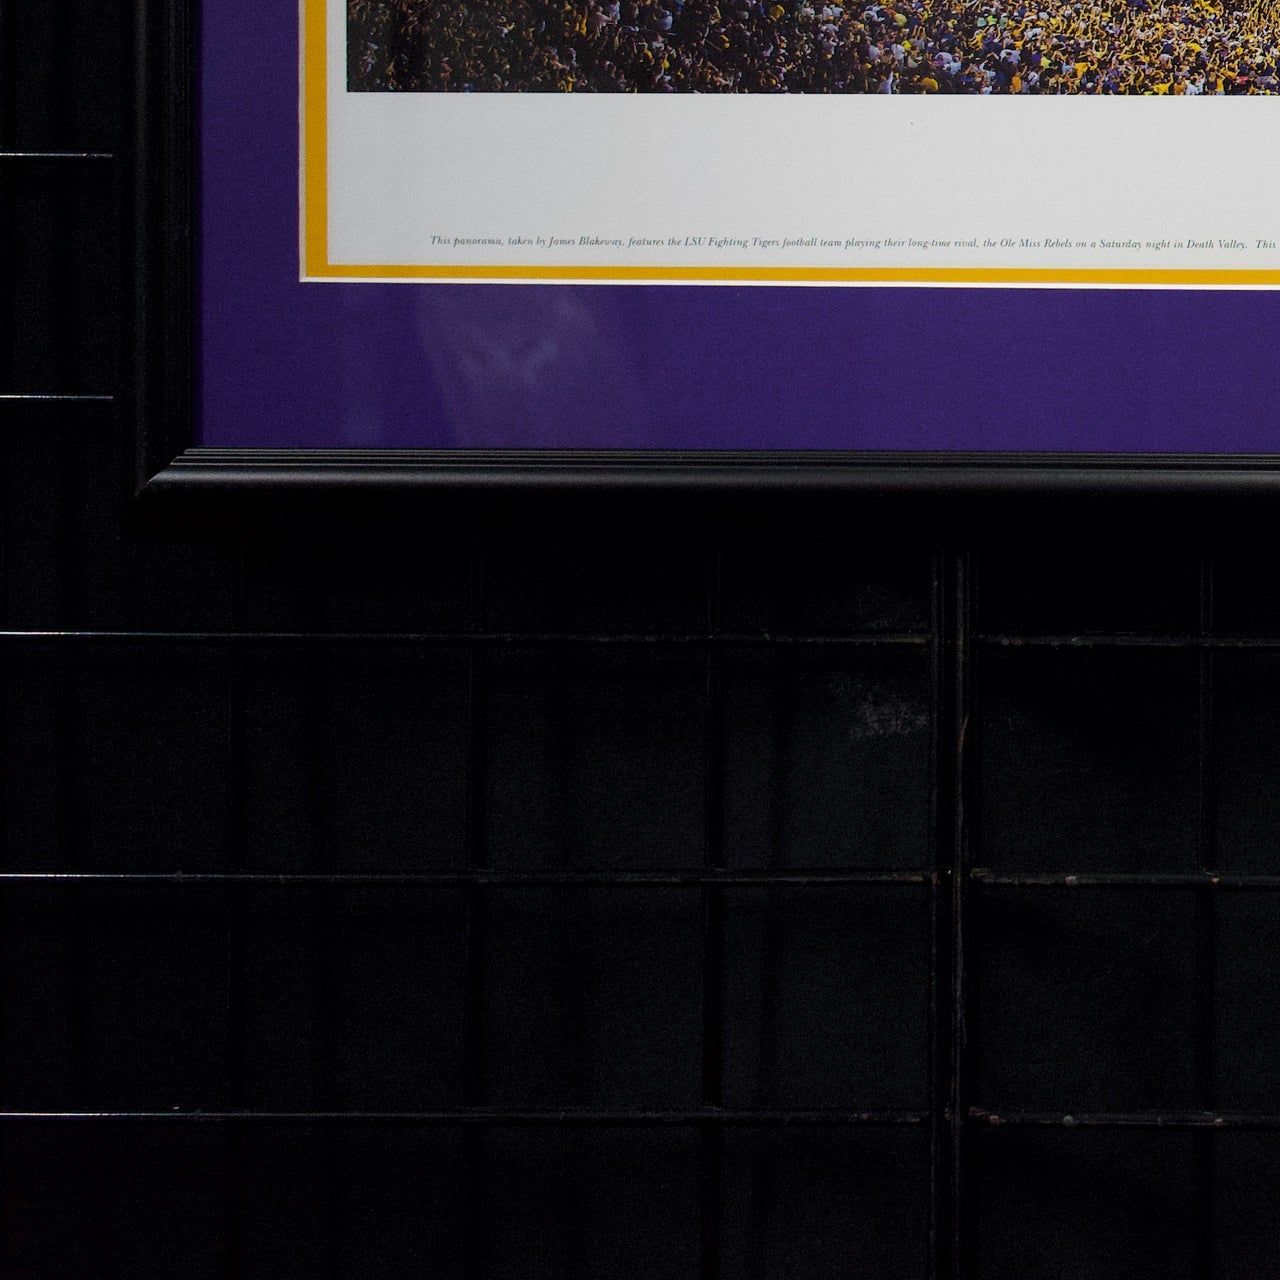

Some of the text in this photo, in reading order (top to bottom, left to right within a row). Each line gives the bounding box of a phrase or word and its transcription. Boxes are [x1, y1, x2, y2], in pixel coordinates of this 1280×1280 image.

[431, 235, 451, 245] This
[507, 236, 533, 245] taken
[535, 236, 546, 248] by
[549, 236, 576, 246] James
[627, 236, 665, 248] features
[667, 236, 682, 246] the
[684, 236, 707, 246] LSU
[708, 237, 749, 248] Fighting
[751, 237, 780, 248] Tigers
[781, 237, 818, 249] football
[819, 238, 842, 247] team
[844, 237, 881, 249] playing
[884, 237, 905, 247] their
[908, 237, 951, 249] long-time
[983, 238, 997, 247] the
[999, 238, 1016, 247] Ole
[1019, 238, 1041, 248] Miss
[1044, 238, 1073, 248] Rebels
[1075, 240, 1087, 248] on
[1090, 240, 1096, 248] a
[1099, 238, 1142, 250] Saturday
[1145, 238, 1171, 250] night
[1173, 239, 1184, 248] in
[1187, 239, 1215, 248] Death
[1255, 239, 1277, 249] This
